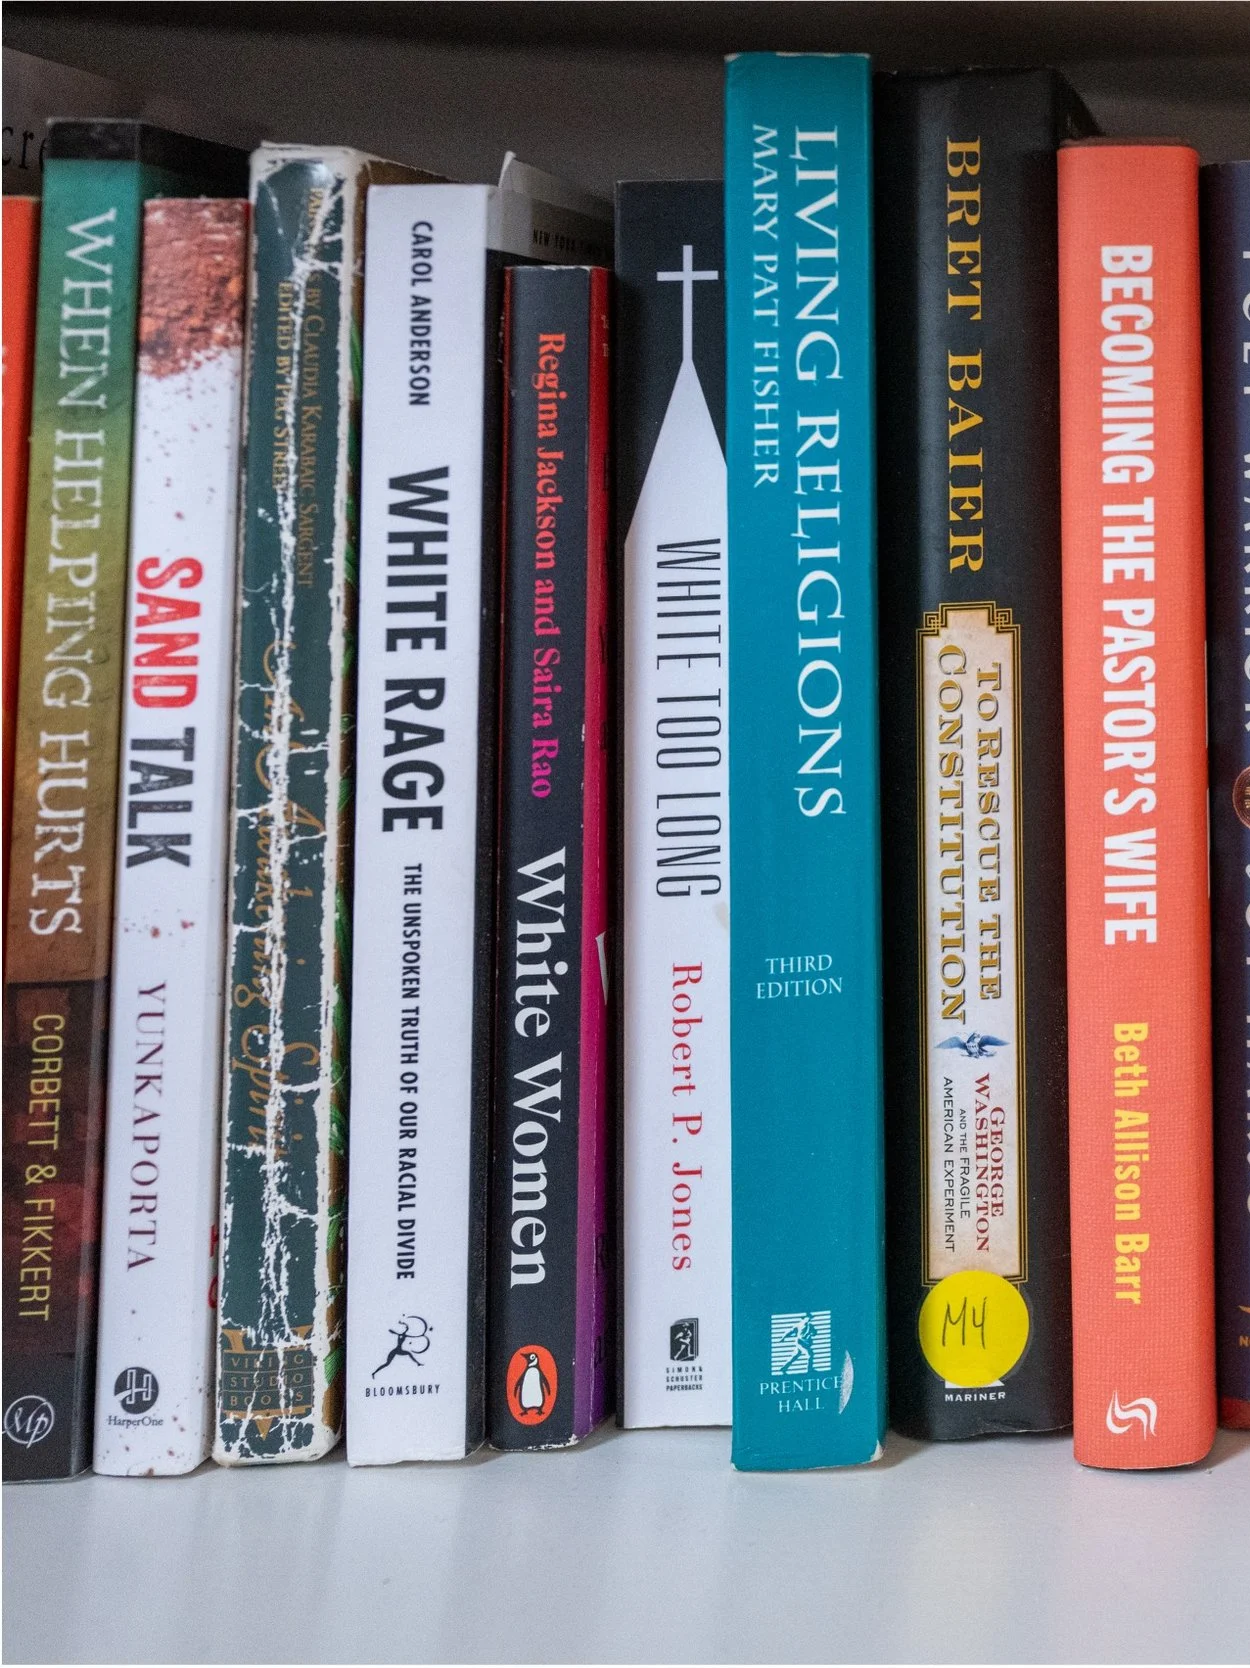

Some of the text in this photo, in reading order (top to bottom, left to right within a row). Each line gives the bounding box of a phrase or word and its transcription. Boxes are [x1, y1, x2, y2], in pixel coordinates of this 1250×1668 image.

[408, 220, 433, 406] CAROL ANDERSON
[946, 135, 985, 574] BRET BAIER
[28, 207, 118, 936] WHEN HELPING HURTS
[789, 125, 847, 818] LIVING RELIGIONS
[1101, 245, 1157, 945] BECOMING THE PASTOR'S WIFE
[125, 556, 205, 869] SAND TALK
[381, 465, 450, 833] WHITE RAGE
[655, 538, 722, 897] WHITE TOO LONG
[765, 954, 833, 975] THIRD
[938, 643, 967, 1025] CONSTITUTION
[976, 661, 1003, 1001] TO RESCUE THE
[127, 981, 168, 1273] YUNKAPORTA
[396, 863, 423, 1280] THE UNSPOKEN TRUTH OF OUR RACIAL DIVIDE
[510, 846, 568, 1289] White Women
[756, 977, 843, 999] EDITION
[19, 1013, 66, 1321] CORBETT & FIKKERT
[943, 1076, 955, 1253] AMERICAN EXPERIMENT
[959, 1108, 971, 1219] AND THE FRAGILE
[974, 1073, 990, 1253] WASHINGTON
[990, 1106, 1006, 1218] GEORGE
[1113, 1022, 1150, 1306] Beth Allison Barr
[106, 1415, 164, 1429] HarperOne
[365, 1383, 441, 1398] BLOOMSBURY
[759, 1375, 843, 1396] PRENTICE
[778, 1398, 825, 1413] HALL
[941, 1296, 988, 1350] M4
[944, 1391, 1007, 1402] MARINER
